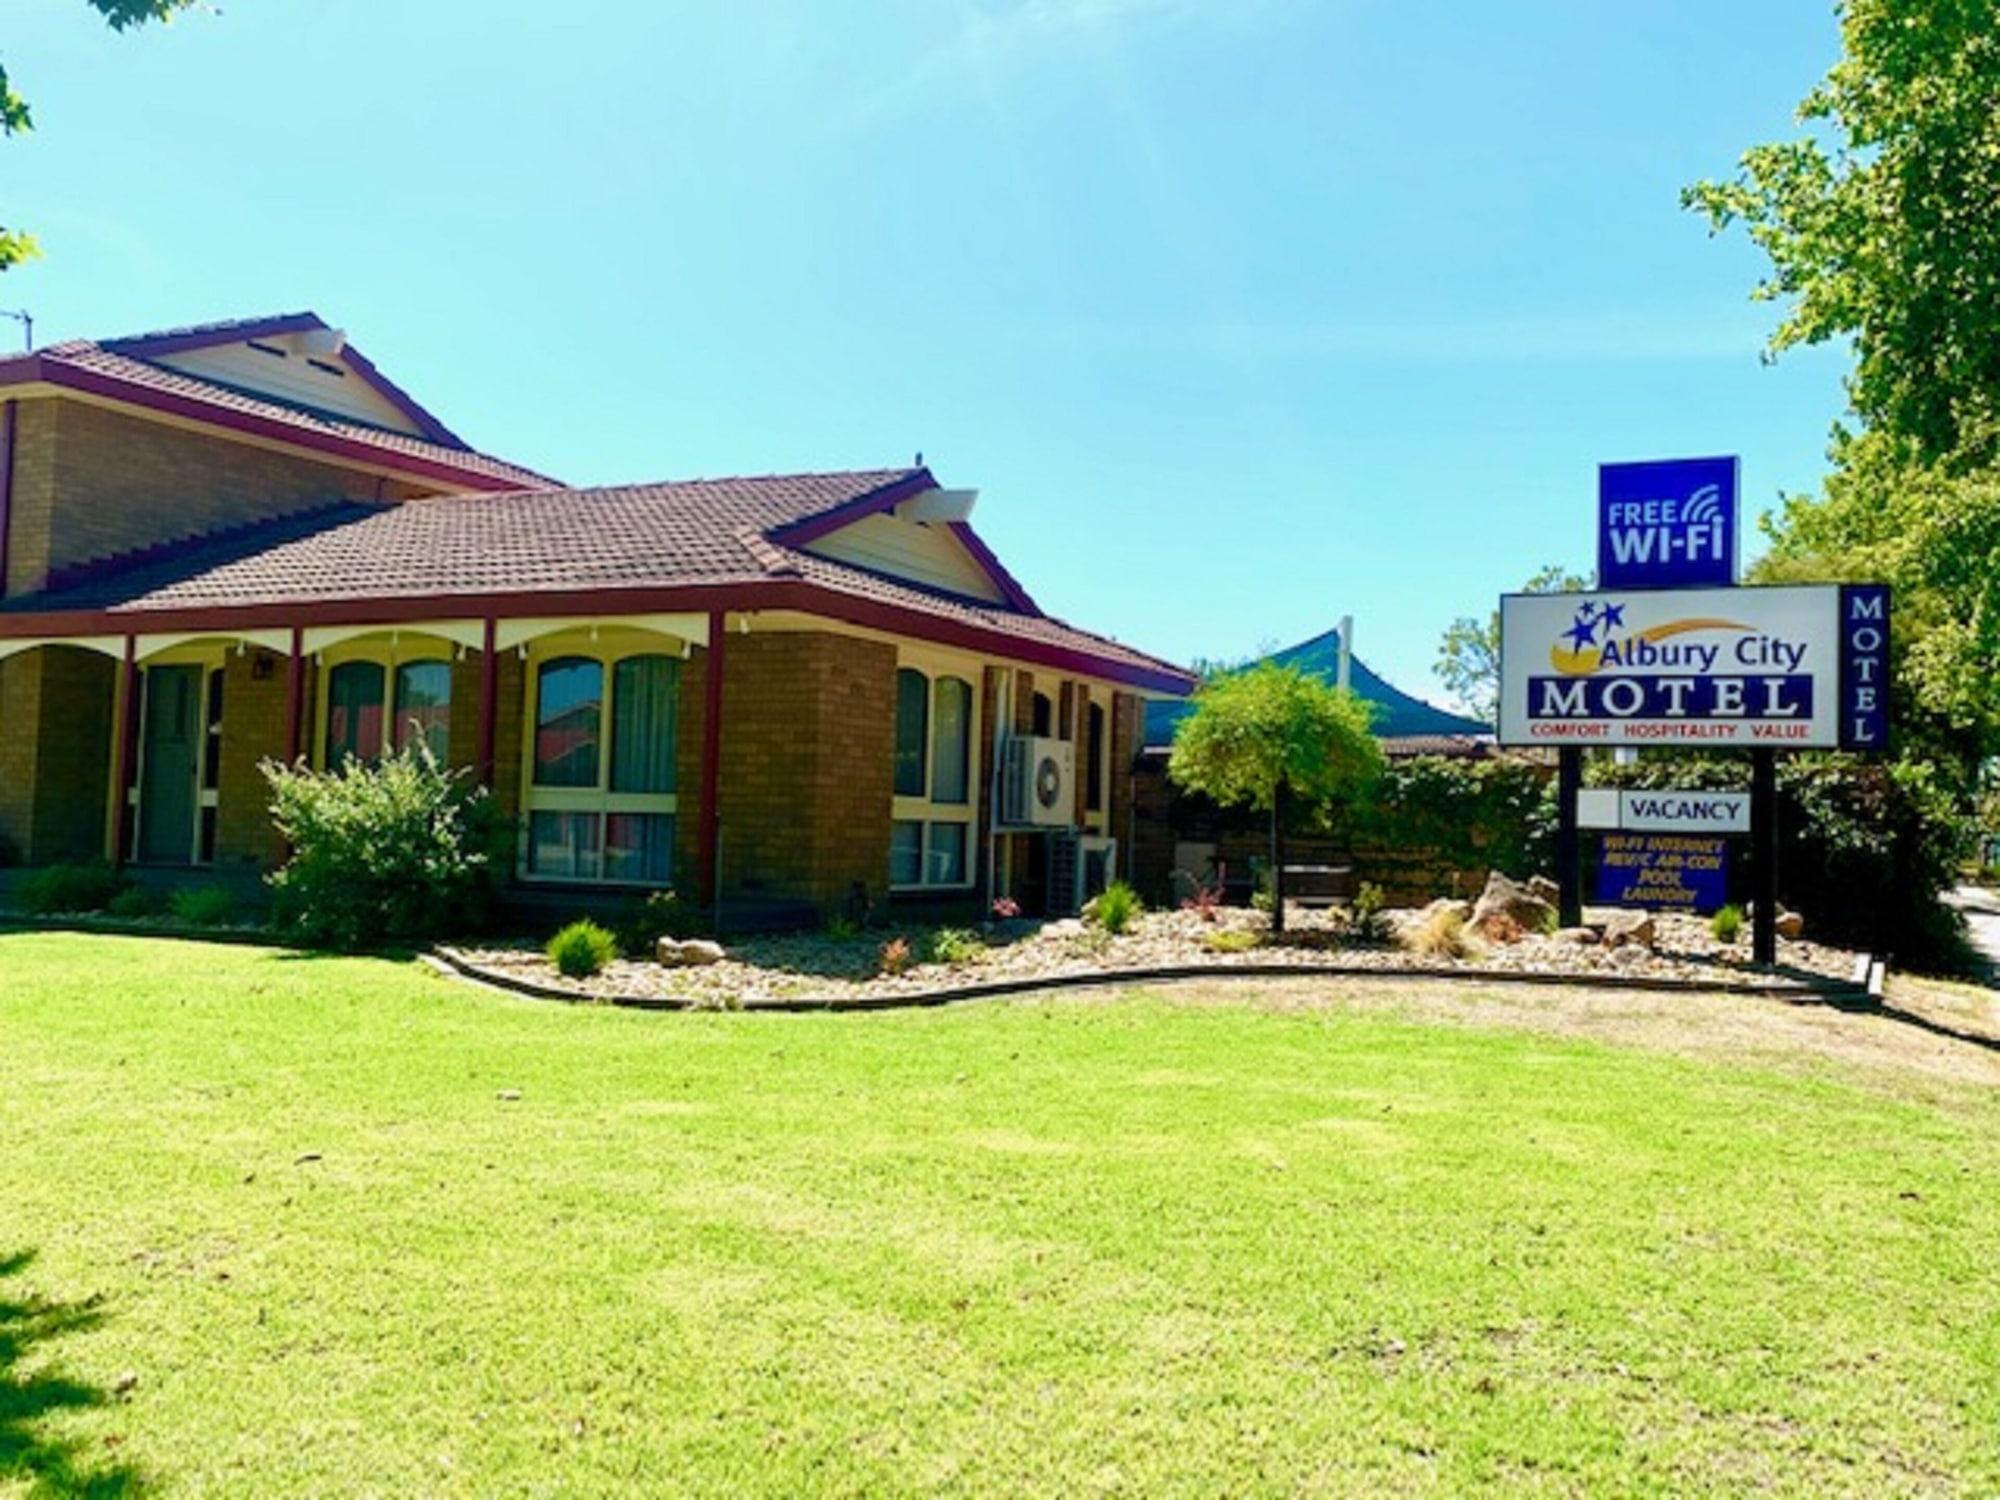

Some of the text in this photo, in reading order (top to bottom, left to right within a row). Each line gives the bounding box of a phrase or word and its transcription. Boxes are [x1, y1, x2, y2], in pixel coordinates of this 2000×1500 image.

[1608, 500, 1678, 526] FREE
[1599, 636, 1808, 672] Albury City
[1851, 595, 1883, 742] MOTEL
[1540, 677, 1799, 717] MOTEL
[1529, 723, 1810, 738] COMFORT HOSPITALITY VALUE
[1631, 799, 1741, 821] VACANCY
[1638, 868, 1683, 886] POOL
[1622, 886, 1698, 902] LAUNDRY
